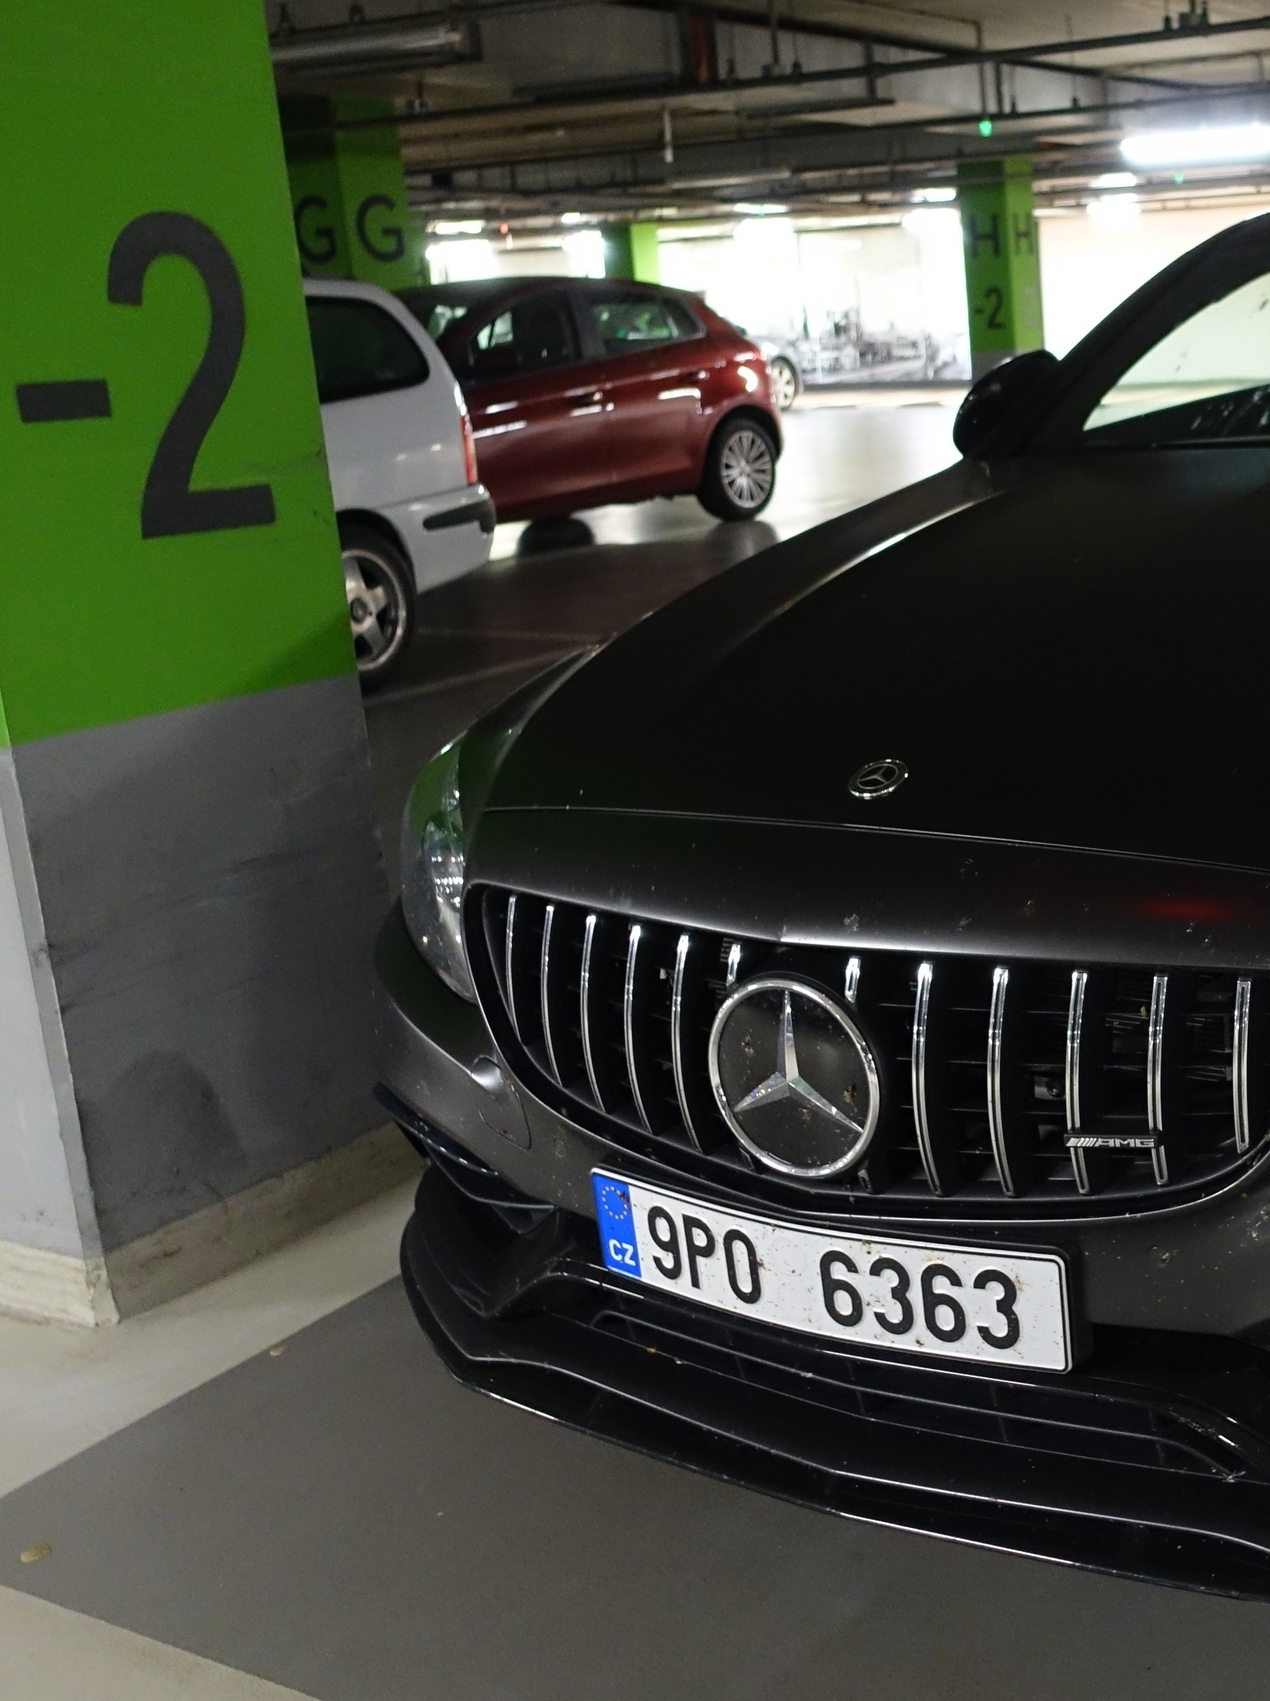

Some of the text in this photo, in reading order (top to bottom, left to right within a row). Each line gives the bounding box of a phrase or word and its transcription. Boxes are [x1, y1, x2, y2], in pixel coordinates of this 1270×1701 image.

[295, 195, 336, 264] G
[356, 194, 405, 262] G
[970, 213, 1000, 259] H
[1012, 213, 1035, 256] H
[974, 286, 1006, 329] -2
[15, 211, 276, 539] -2
[1094, 1138, 1155, 1148] AMG
[609, 1239, 636, 1266] CZ
[647, 1205, 1021, 1350] 9P0 6363
